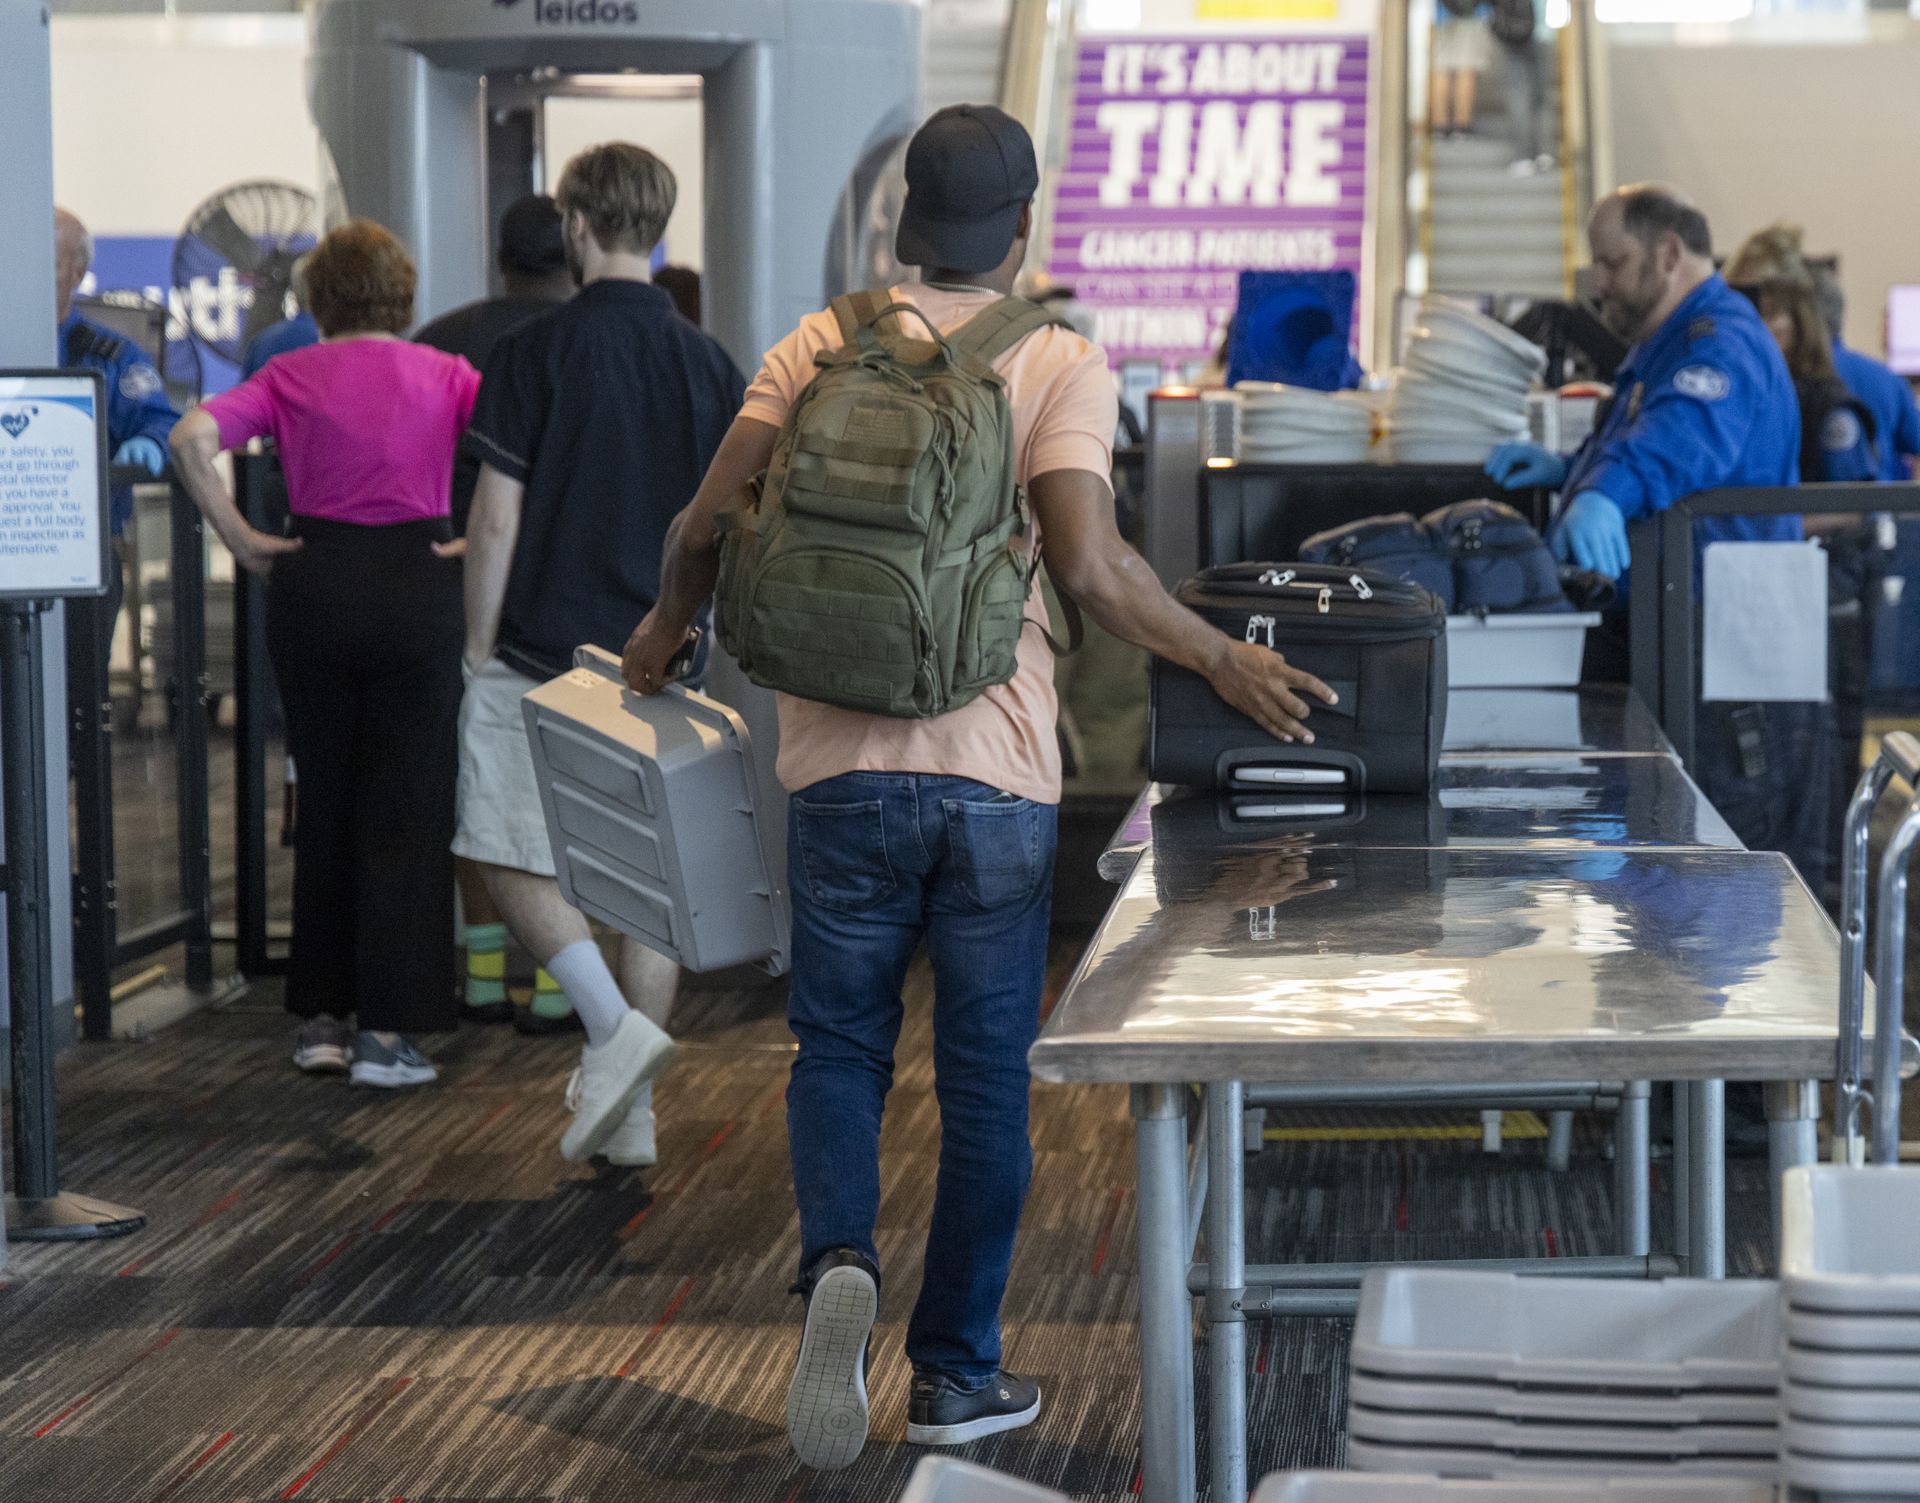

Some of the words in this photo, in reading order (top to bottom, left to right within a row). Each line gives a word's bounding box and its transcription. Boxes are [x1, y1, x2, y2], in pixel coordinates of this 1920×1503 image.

[535, 0, 638, 24] leidos
[1101, 42, 1188, 95] IT'S
[1190, 42, 1346, 95] ABOUT
[1097, 99, 1345, 208] TIME
[1079, 228, 1196, 270] CANCER
[1199, 228, 1338, 270] PATIENTS
[52, 448, 73, 458] you
[16, 462, 30, 472] go
[34, 459, 79, 472] through
[21, 474, 68, 485] detector
[5, 489, 26, 500] you
[30, 488, 58, 498] have
[61, 489, 69, 498] a
[25, 517, 31, 526] a
[34, 515, 52, 526] full
[56, 514, 85, 527] body
[10, 529, 69, 541] inspection
[72, 531, 85, 540] as
